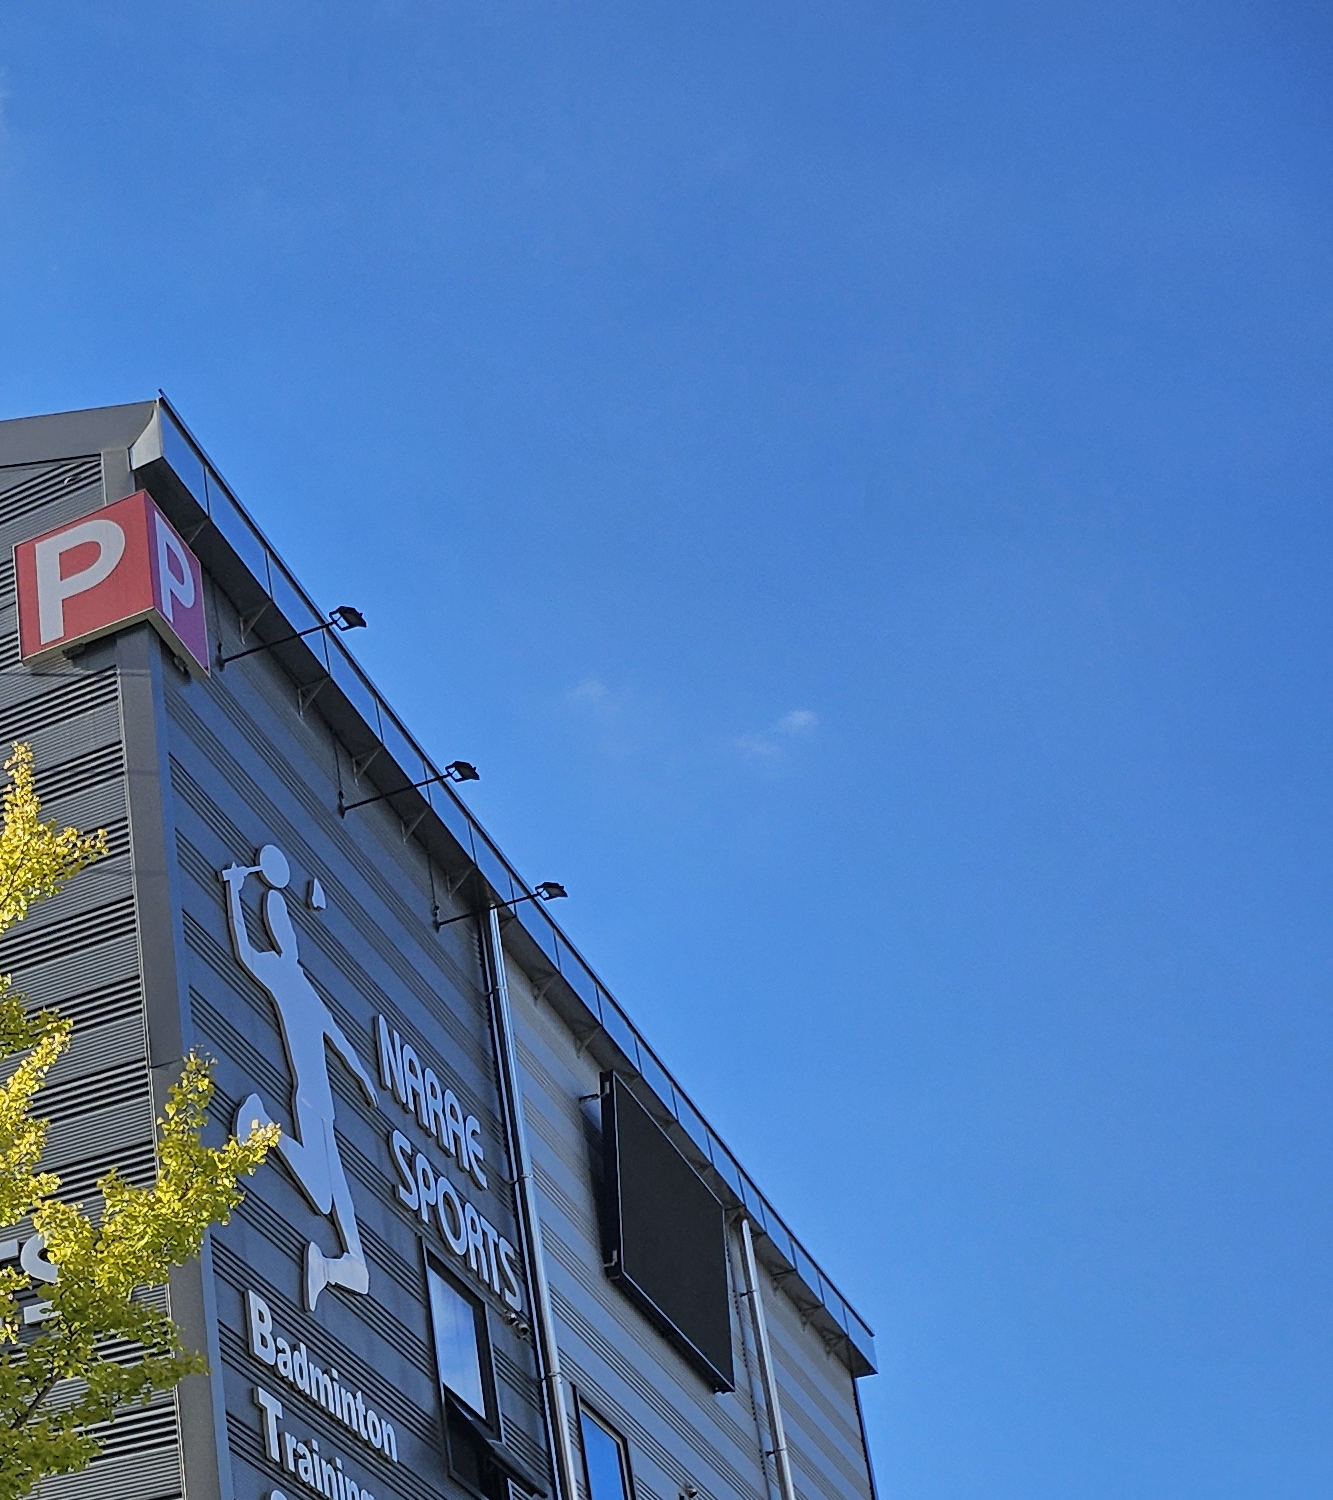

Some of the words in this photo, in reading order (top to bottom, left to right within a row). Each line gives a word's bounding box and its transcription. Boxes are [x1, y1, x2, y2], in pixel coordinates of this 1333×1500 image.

[35, 518, 126, 646] P
[154, 510, 195, 624] P
[376, 1013, 488, 1190] NARAE
[391, 1129, 523, 1312] SPORTS
[246, 1290, 398, 1464] Badminton
